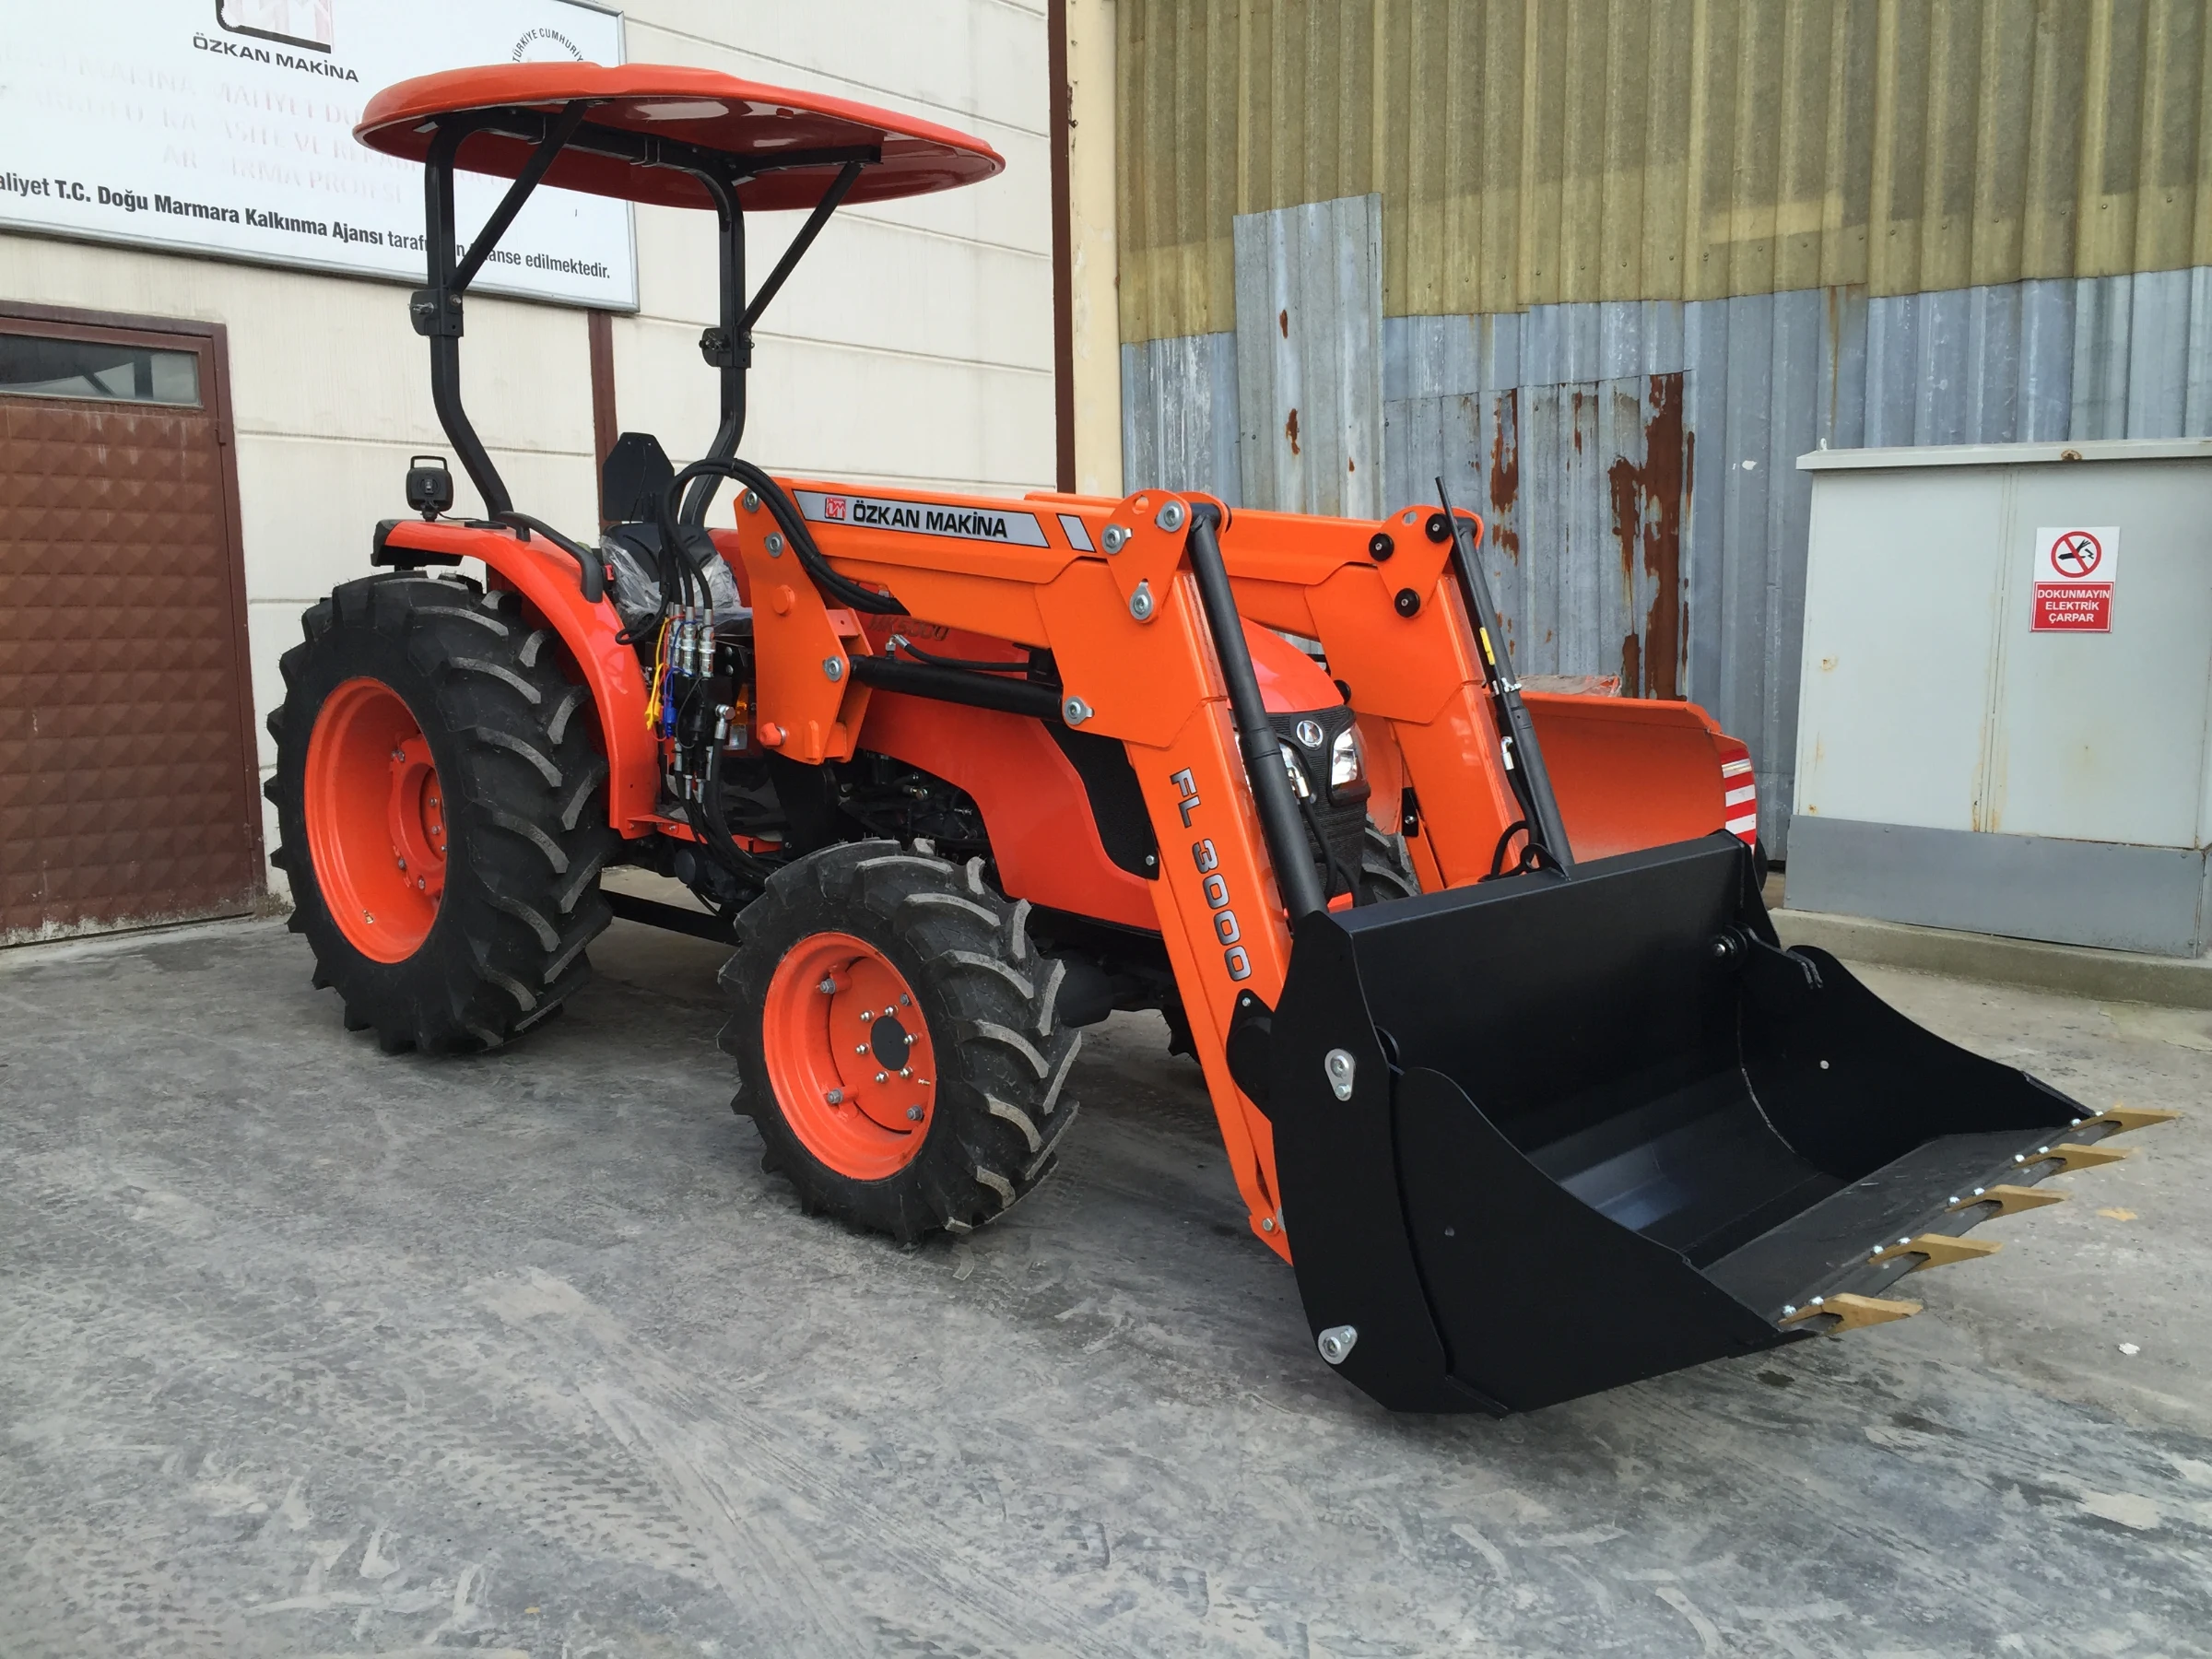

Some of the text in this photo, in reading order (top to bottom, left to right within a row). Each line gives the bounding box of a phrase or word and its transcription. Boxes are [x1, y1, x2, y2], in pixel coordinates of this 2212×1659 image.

[193, 32, 359, 83] ÖZKAN MAKİNA
[512, 28, 583, 63] TÜRKİYE CUMHURİY
[54, 180, 91, 202] T.C.
[98, 185, 148, 212] Doğu
[154, 194, 240, 223] Marmara
[245, 207, 327, 236] Kalkınma
[332, 221, 383, 244] Ajansı
[525, 253, 610, 278] edilmektedir.
[853, 500, 1007, 538] ÖZKAN MAKİNA
[2037, 589, 2110, 599] DOKUNMAYIN
[2045, 600, 2100, 611] ELEKTRİK
[2049, 613, 2094, 623] ÇARPAR
[1170, 767, 1252, 982] FL 3000
